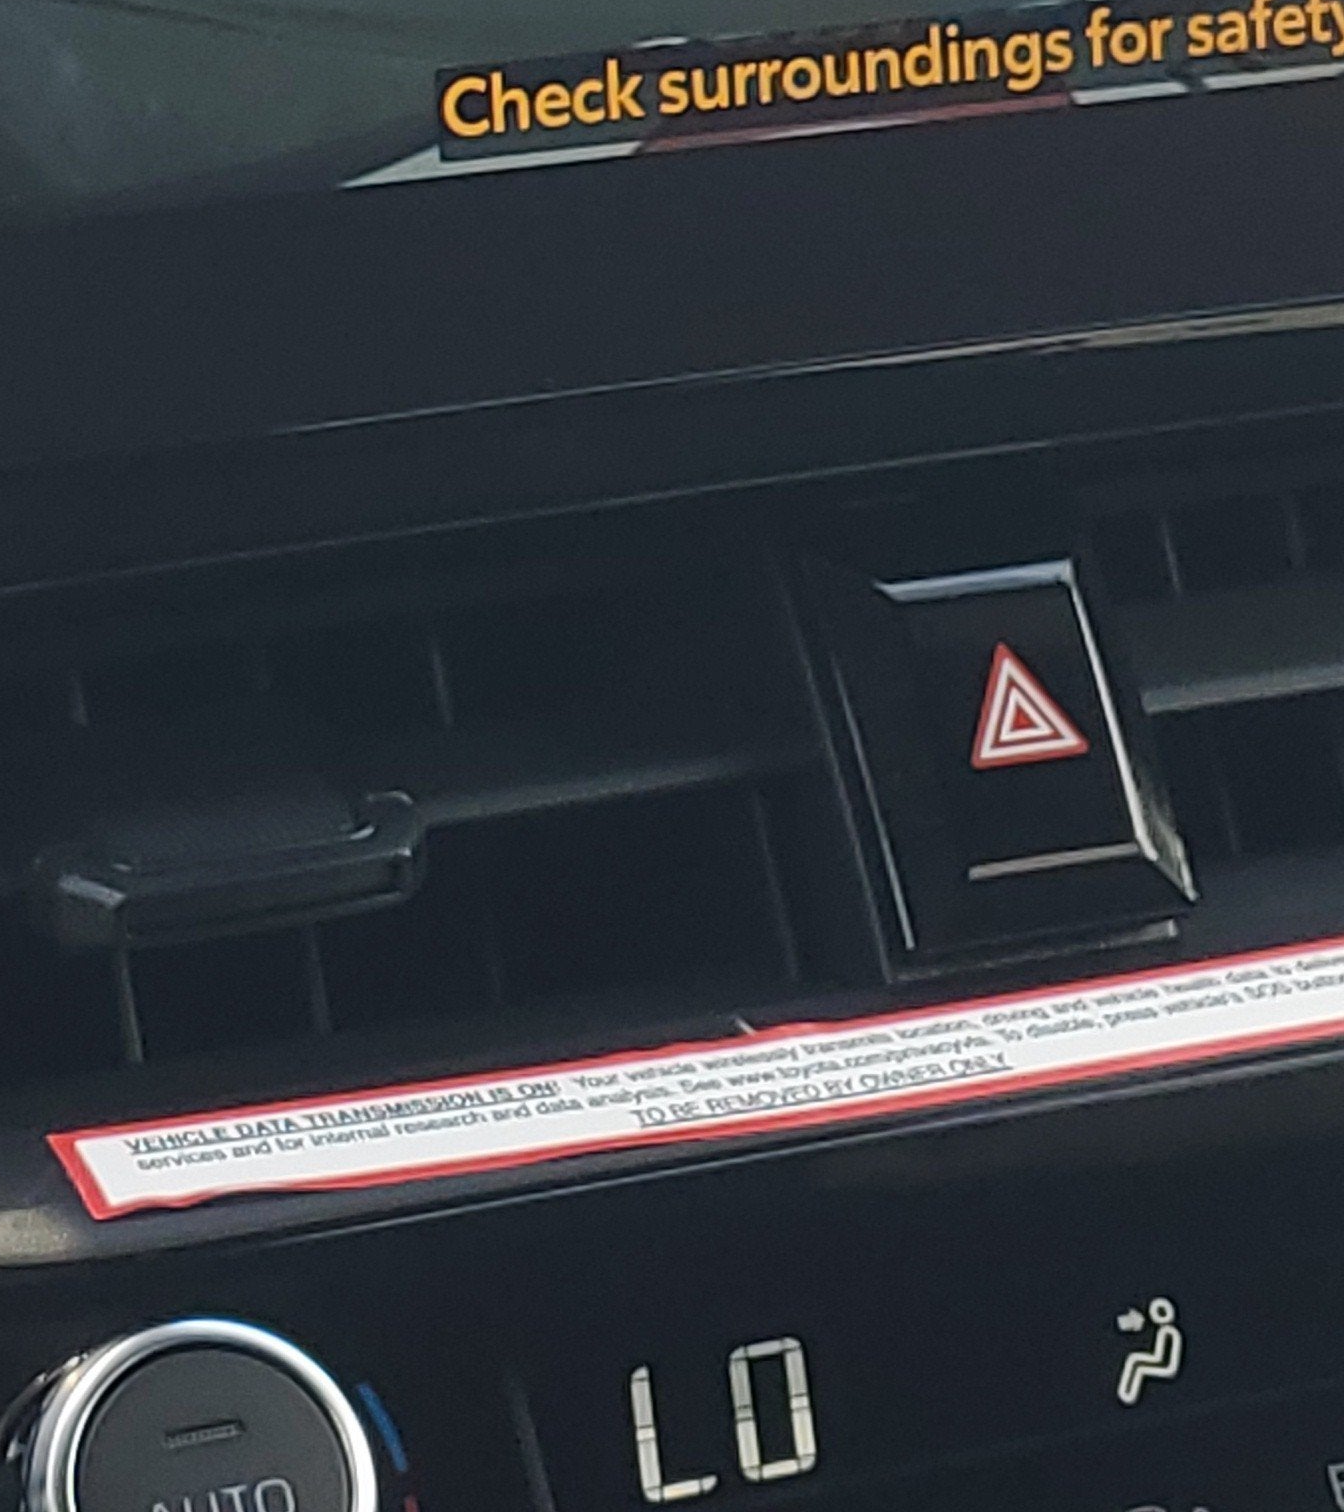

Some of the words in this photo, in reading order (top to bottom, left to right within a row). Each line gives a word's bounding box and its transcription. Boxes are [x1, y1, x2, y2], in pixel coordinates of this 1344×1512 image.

[442, 58, 646, 137] Check
[659, 22, 1073, 115] surroundings
[1086, 7, 1173, 67] for
[124, 1125, 226, 1153] VEHICLE
[235, 1116, 298, 1139] DATA
[301, 1091, 484, 1128] TRANSMISSION
[489, 1086, 513, 1103] IS
[575, 1074, 618, 1088] Your
[625, 1063, 697, 1081] vehicle
[1052, 999, 1089, 1014] and
[137, 1147, 227, 1171] services
[233, 1140, 273, 1158] and
[275, 1135, 305, 1152] for
[309, 1122, 390, 1147] internal
[394, 1111, 488, 1135] research
[492, 1101, 533, 1121] and
[536, 1096, 584, 1116] data
[679, 1079, 722, 1094] See
[631, 1107, 666, 1128] TO
[669, 1101, 699, 1118] BE
[707, 1084, 821, 1115] REMOVED
[824, 1077, 853, 1096] BY
[859, 1062, 946, 1090] OWNER
[949, 1051, 1006, 1076] ONLY
[630, 1336, 818, 1503] LO
